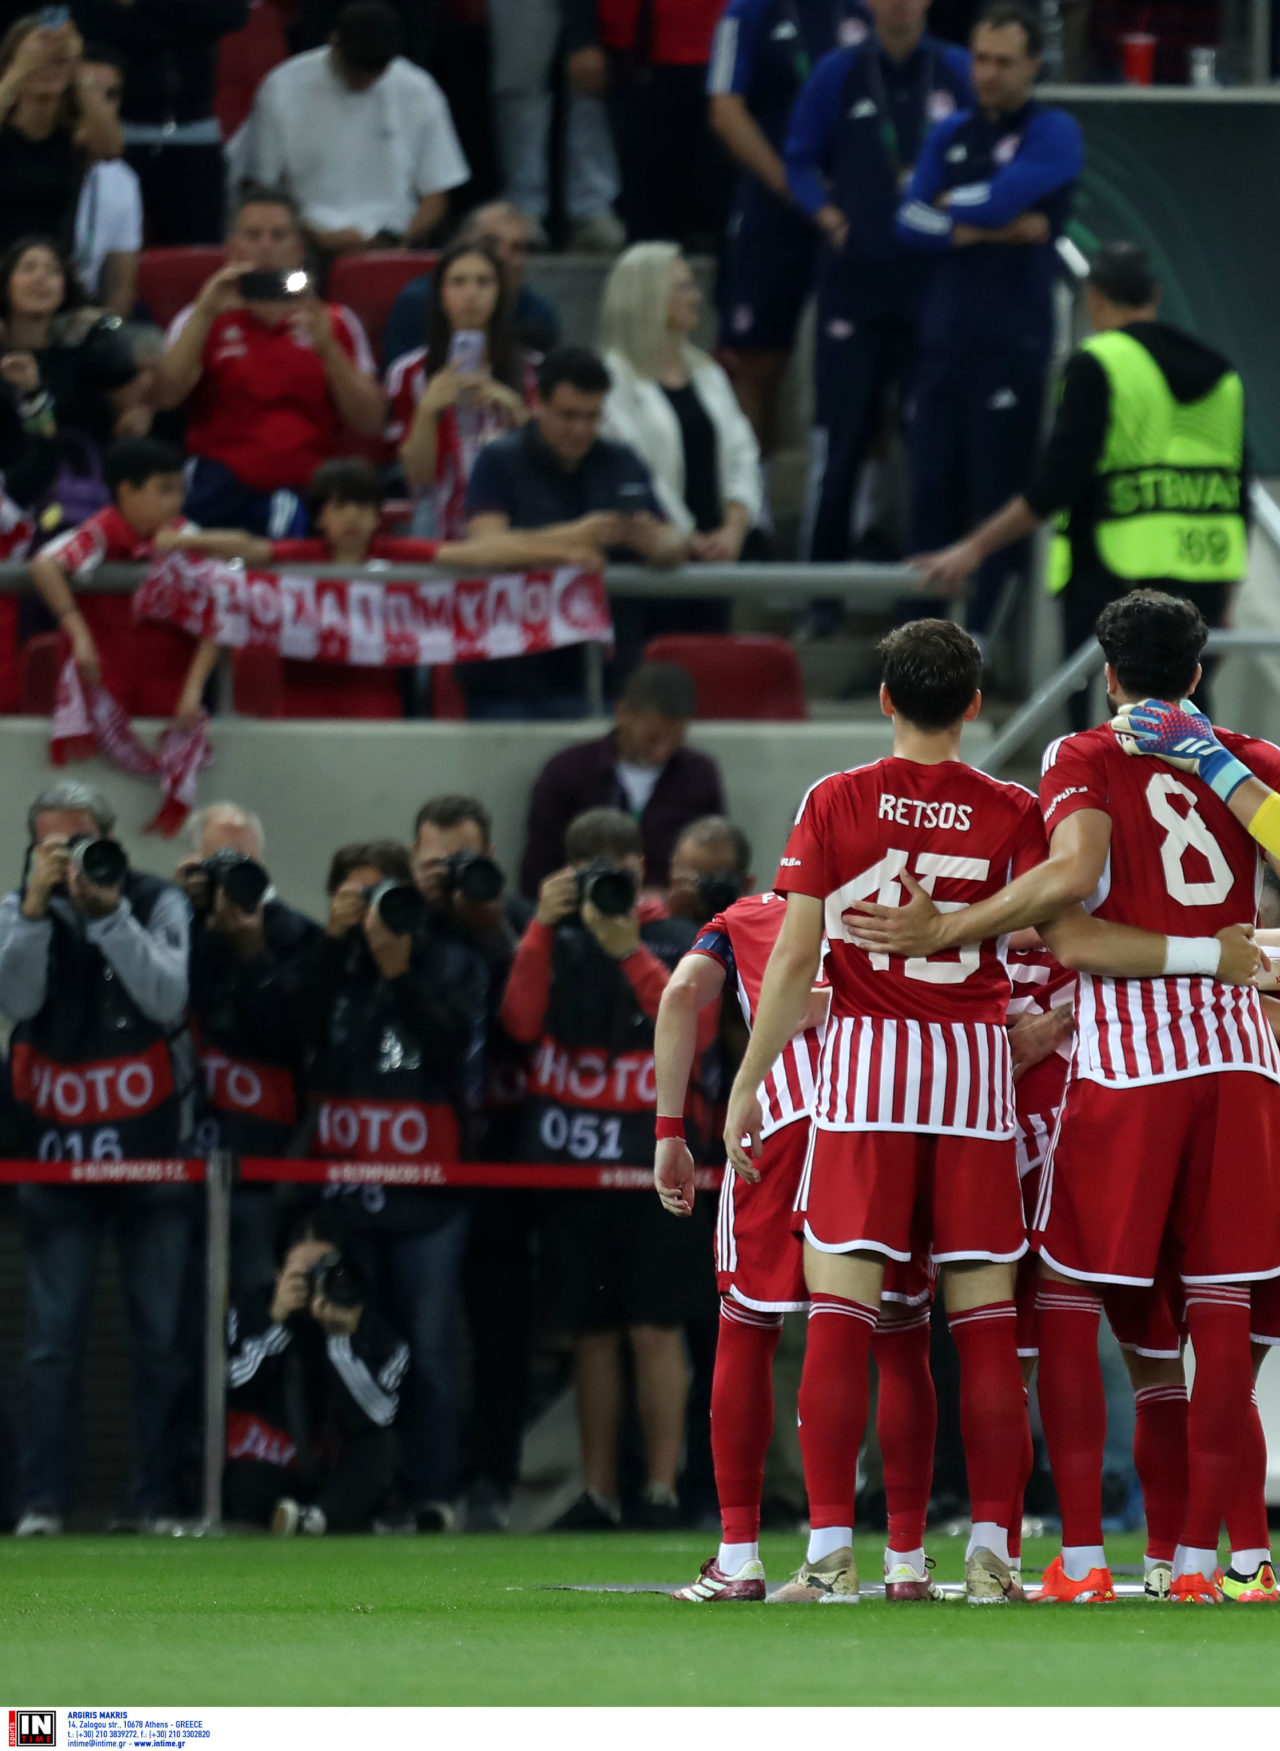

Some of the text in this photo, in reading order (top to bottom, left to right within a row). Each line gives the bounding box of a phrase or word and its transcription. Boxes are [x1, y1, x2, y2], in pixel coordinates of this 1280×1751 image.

[878, 793, 973, 831] RETSOS
[1145, 773, 1234, 906] 8
[825, 848, 990, 984] 45
[39, 1128, 123, 1162] 016
[540, 1106, 623, 1159] 051
